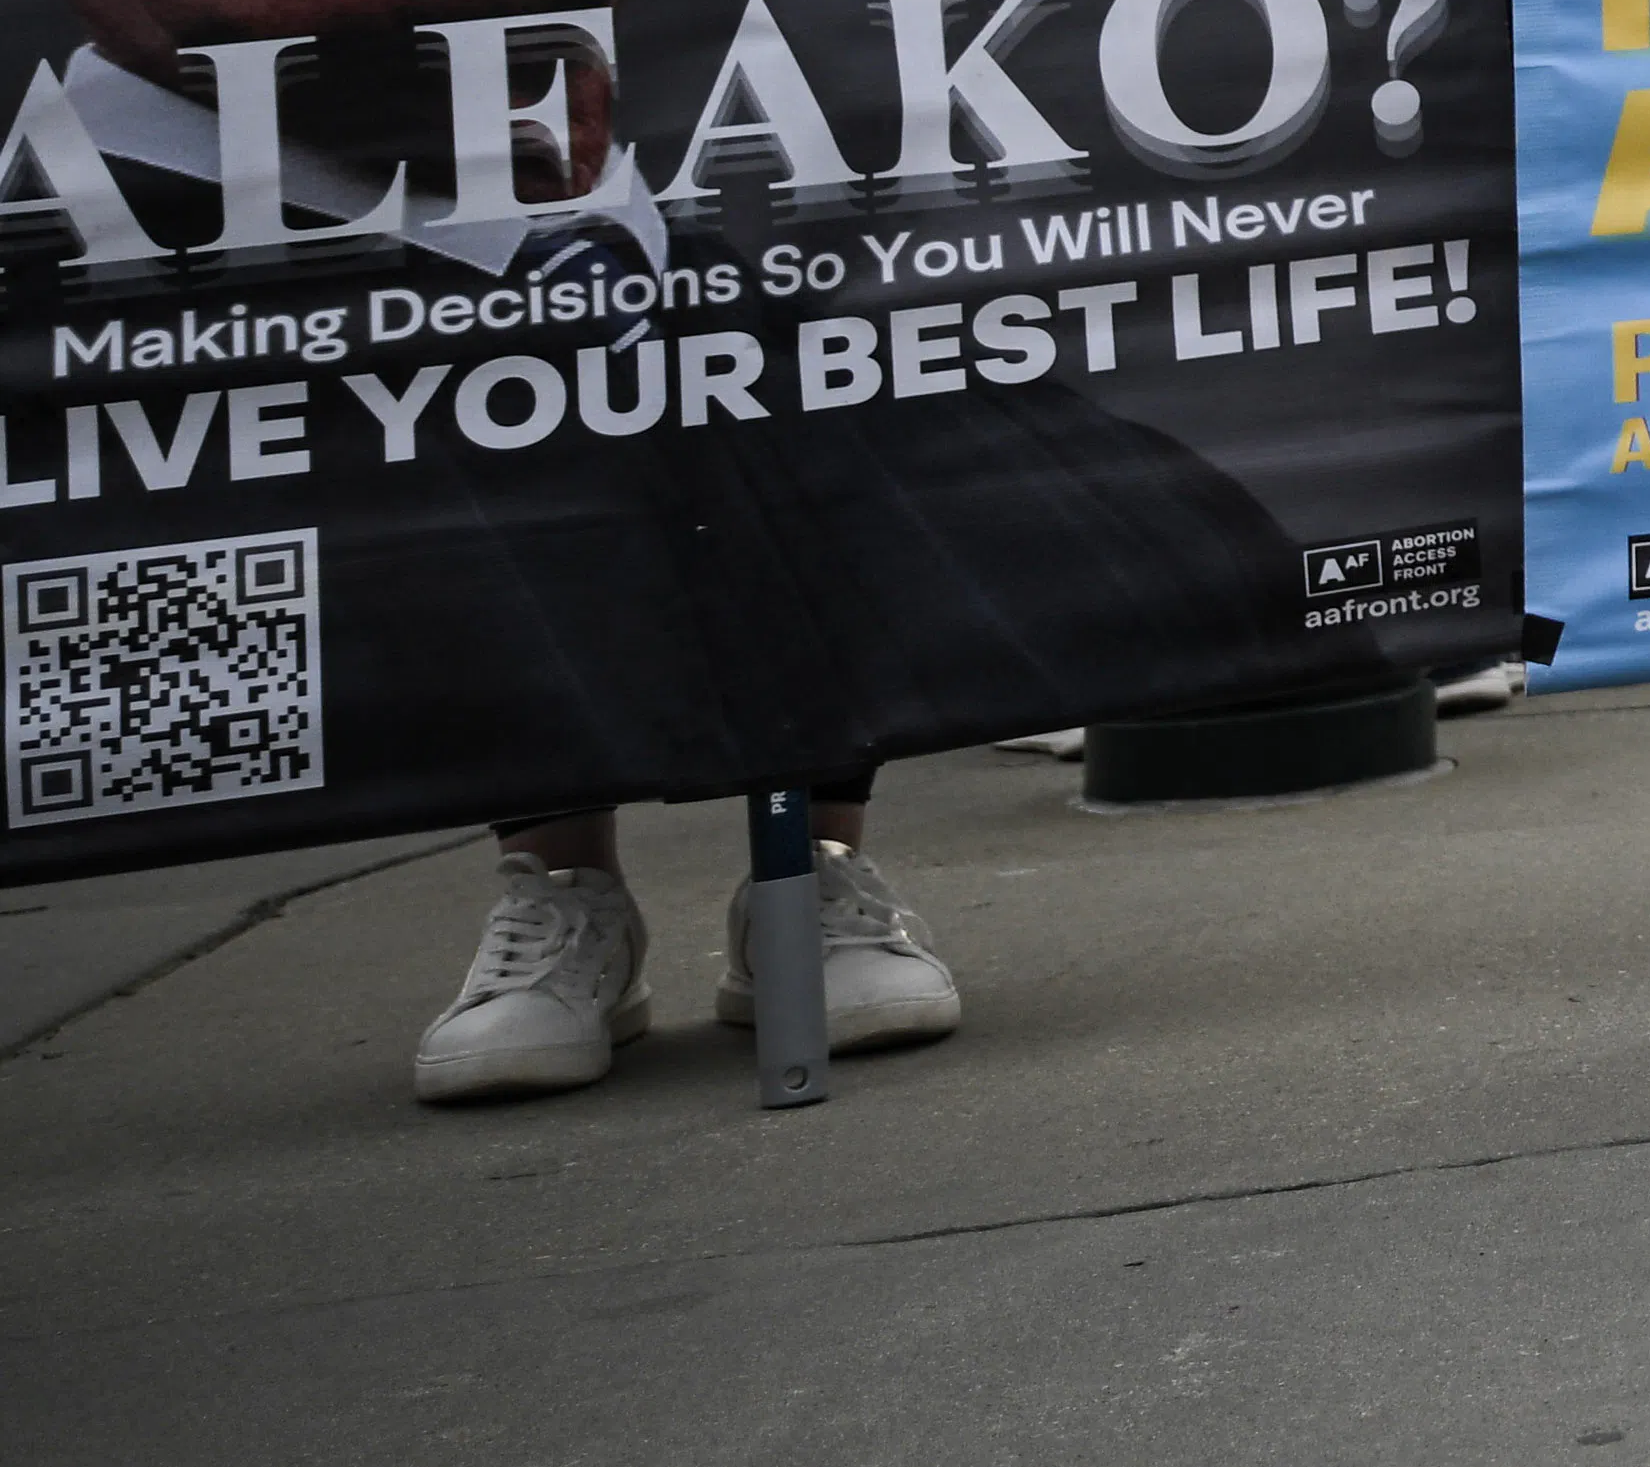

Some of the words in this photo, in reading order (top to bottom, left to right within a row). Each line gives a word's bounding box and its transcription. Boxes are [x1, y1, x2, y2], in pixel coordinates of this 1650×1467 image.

[53, 304, 347, 377] Making
[370, 260, 741, 343] Decisions
[762, 244, 845, 297] So
[864, 232, 1003, 283] You
[1021, 203, 1151, 264] Will
[1174, 189, 1375, 248] Never
[0, 381, 311, 508] LIVE
[342, 330, 772, 463] YOUR
[798, 281, 1138, 412] BEST
[1172, 239, 1478, 361] LIFE!
[1392, 528, 1475, 551] ABORTION
[1393, 546, 1457, 566] ACCESS
[1393, 563, 1447, 582] FRONT
[1305, 584, 1481, 629] aafront.org
